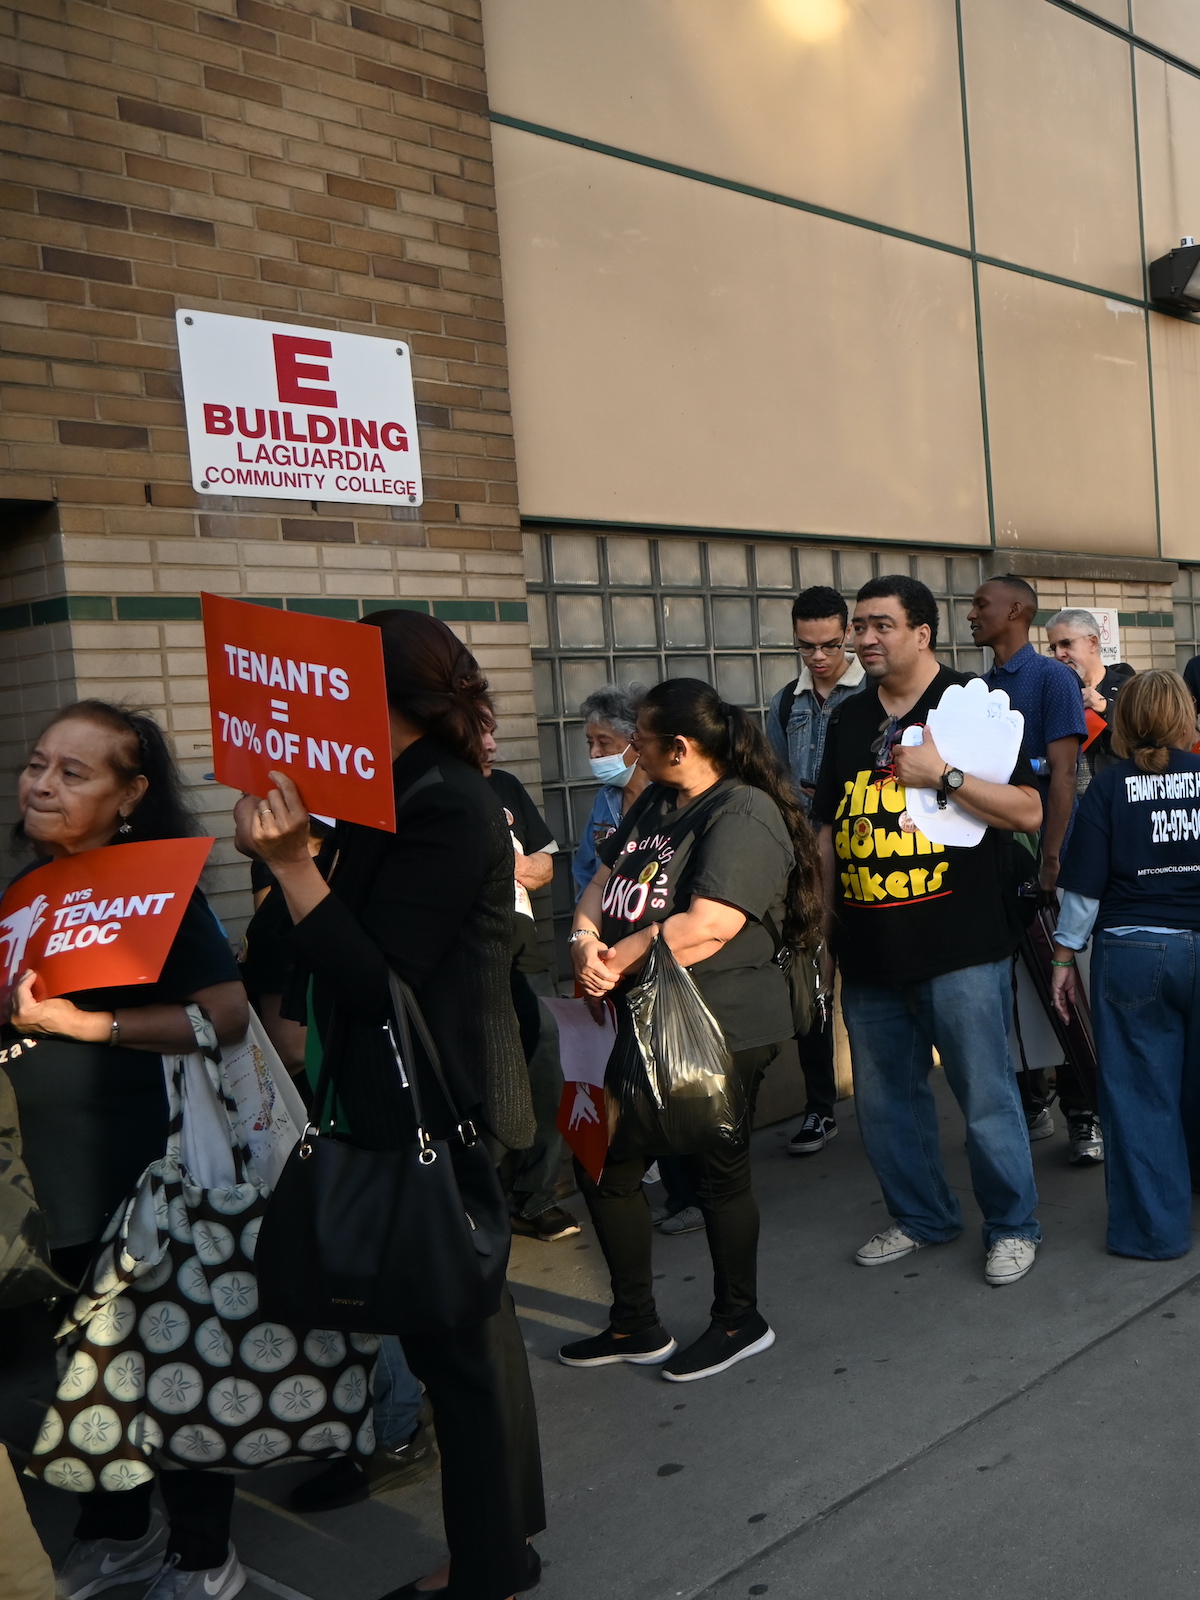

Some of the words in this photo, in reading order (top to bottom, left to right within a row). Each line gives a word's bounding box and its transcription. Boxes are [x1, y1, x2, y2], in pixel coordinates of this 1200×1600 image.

[272, 333, 338, 409] E
[203, 403, 409, 452] BUILDING
[237, 441, 386, 473] LAGUARDIA
[205, 466, 325, 490] COMMUNITY
[335, 475, 417, 496] COLLEGE
[1100, 646, 1118, 654] RKING
[224, 643, 350, 701] TENANTS
[218, 710, 262, 755] 70%
[265, 728, 300, 764] OF
[307, 736, 375, 780] NYC
[1125, 774, 1165, 803] TENANT'S
[1165, 772, 1195, 799] RIGHTS
[62, 888, 93, 905] NYS
[602, 875, 650, 923] UNO
[841, 861, 950, 901] rikers
[52, 892, 175, 931] TENANT
[44, 922, 122, 957] BLOC
